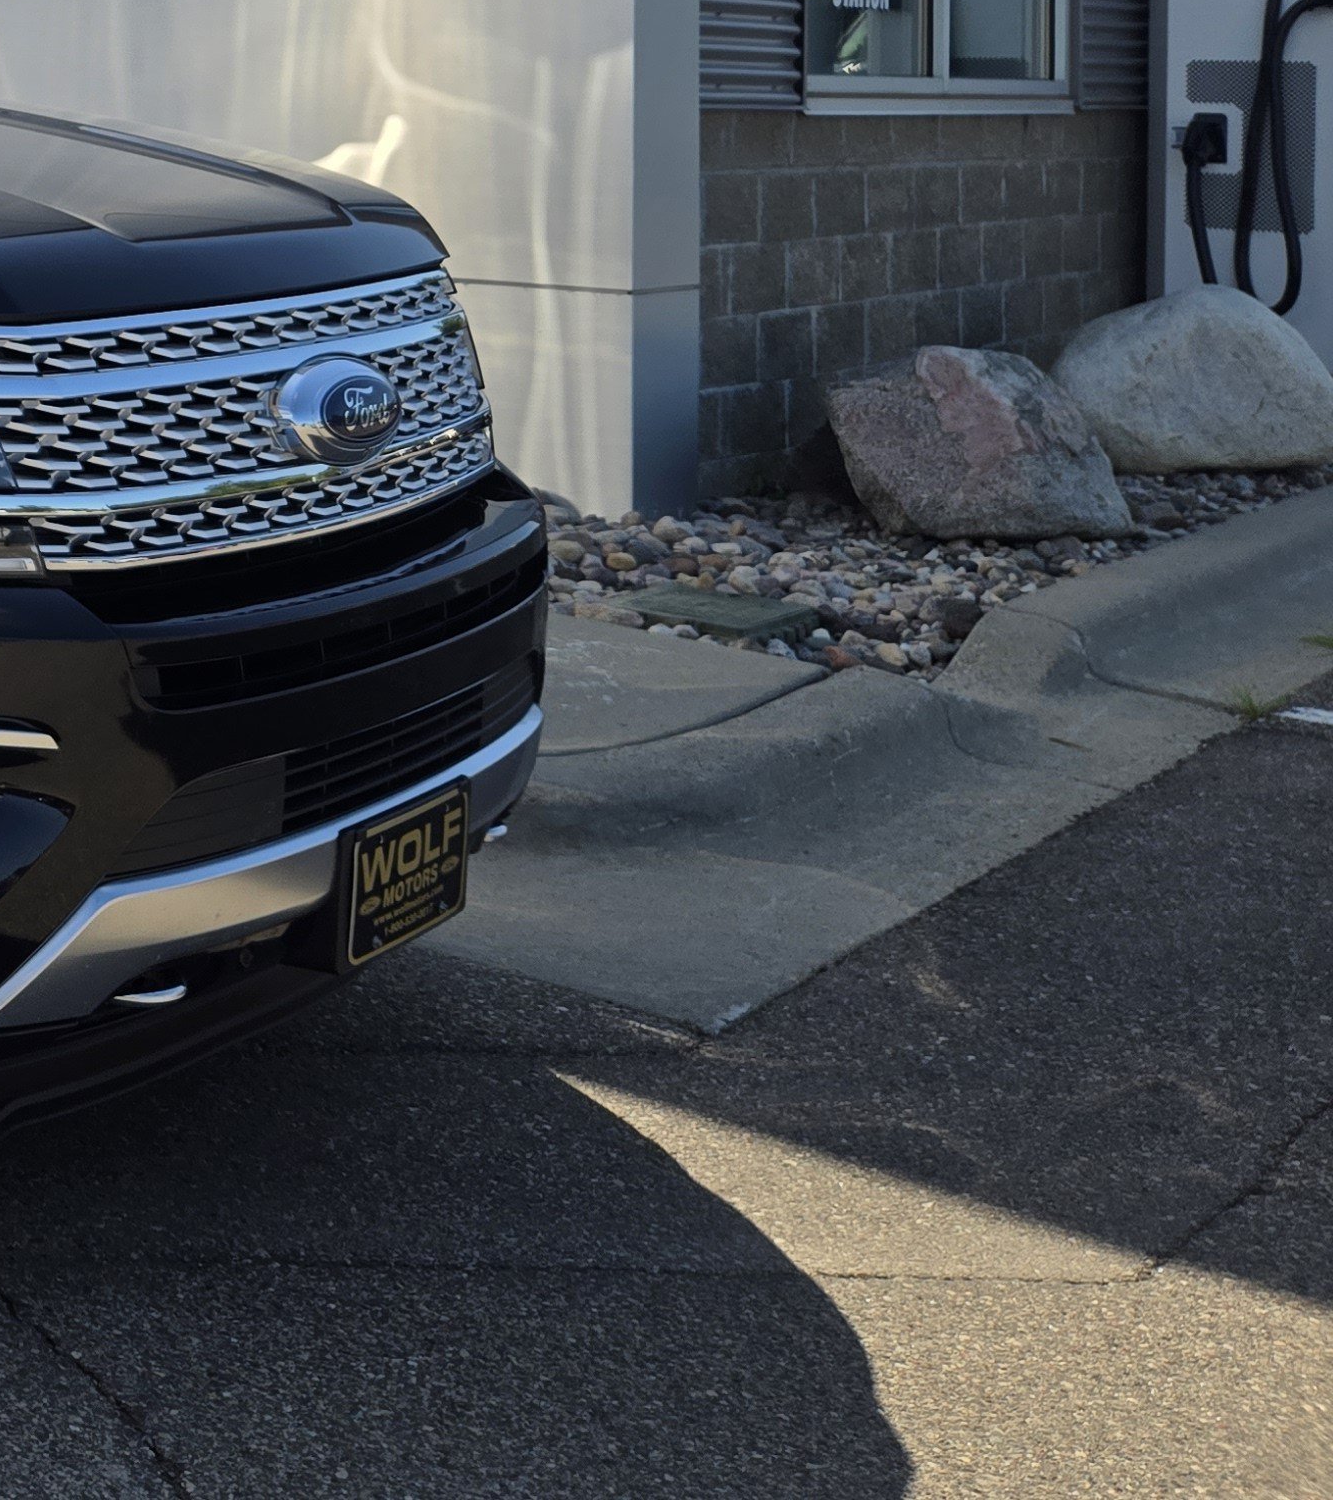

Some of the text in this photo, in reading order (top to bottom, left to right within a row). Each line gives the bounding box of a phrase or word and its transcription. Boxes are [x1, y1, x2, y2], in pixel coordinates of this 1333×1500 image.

[343, 386, 392, 431] Ford
[361, 807, 462, 894] WOLF
[382, 862, 439, 908] MOTORS
